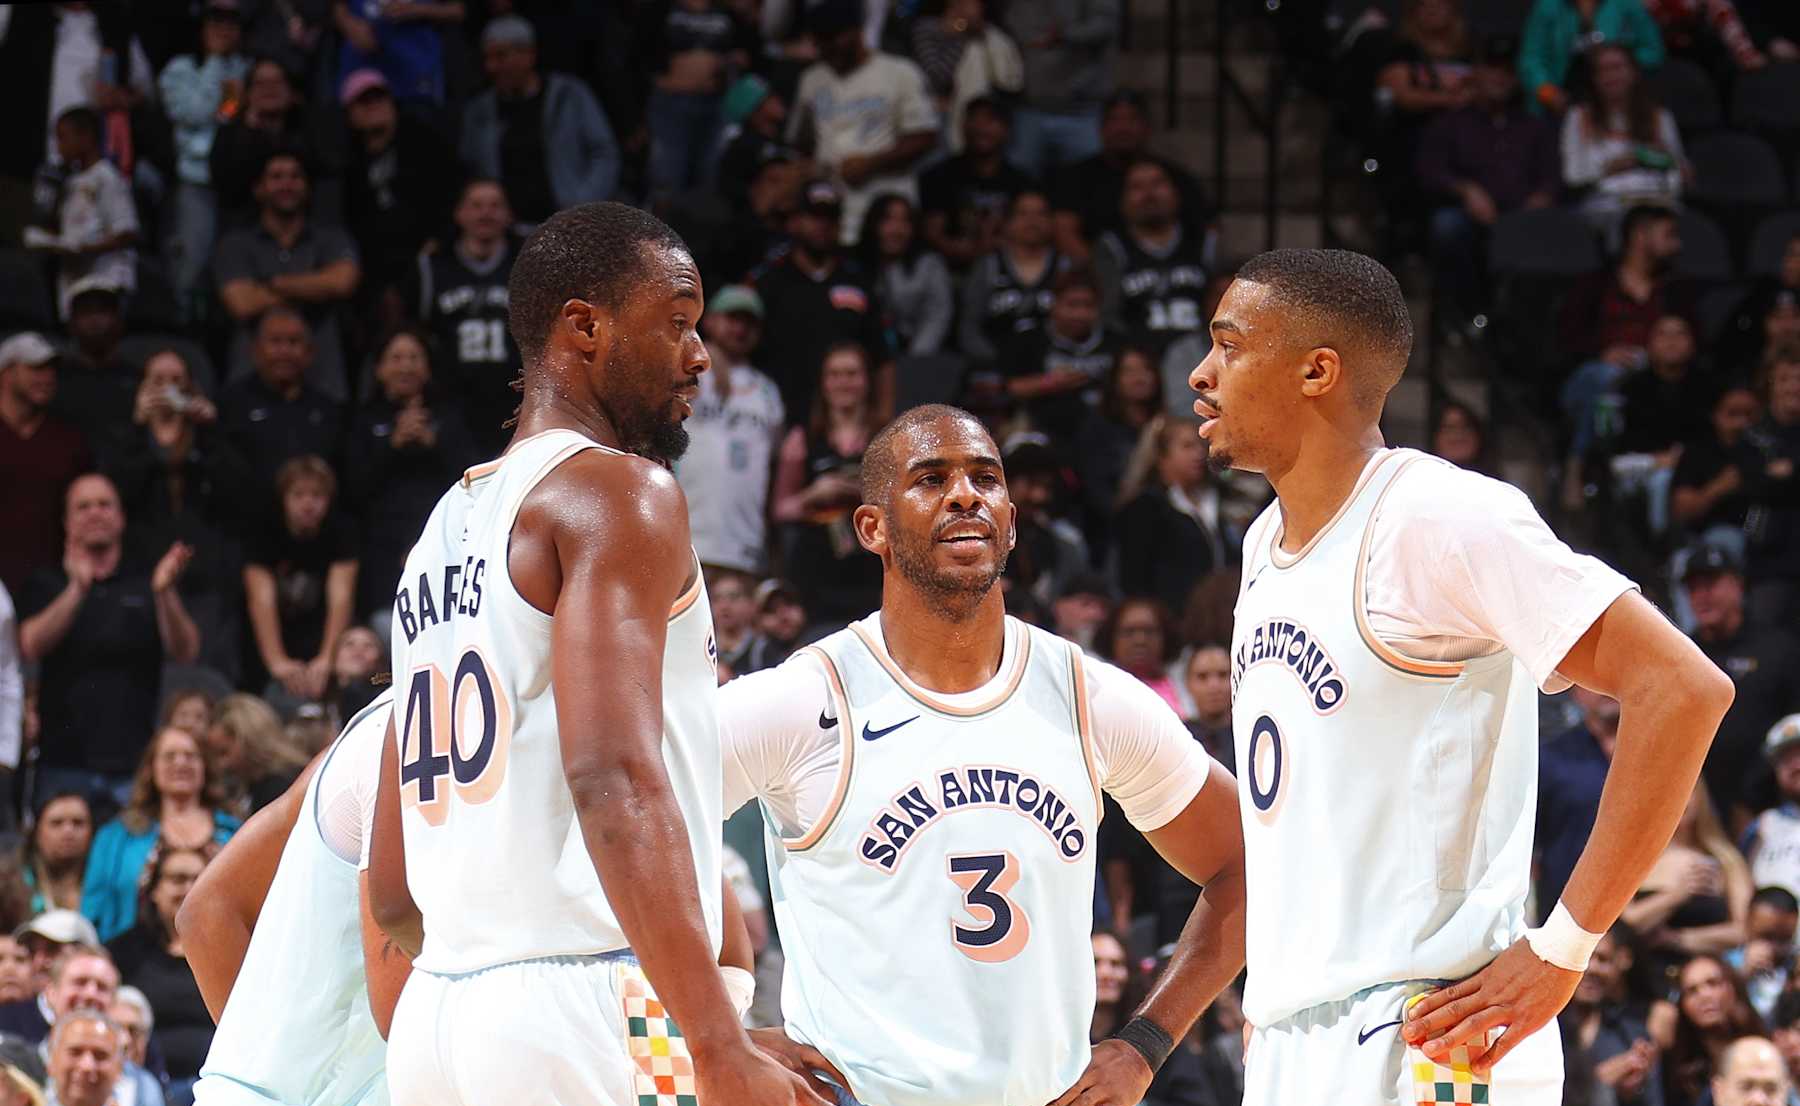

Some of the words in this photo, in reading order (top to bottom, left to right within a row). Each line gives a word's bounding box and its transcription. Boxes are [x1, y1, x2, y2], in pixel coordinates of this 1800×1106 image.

[458, 319, 506, 361] 21
[396, 556, 486, 646] BARES
[1249, 621, 1344, 711] ANTONIO
[401, 647, 500, 806] 40
[1248, 714, 1284, 814] 0
[861, 786, 938, 869] SAN
[939, 768, 1085, 858] ANTONIO
[950, 854, 1018, 951] 3
